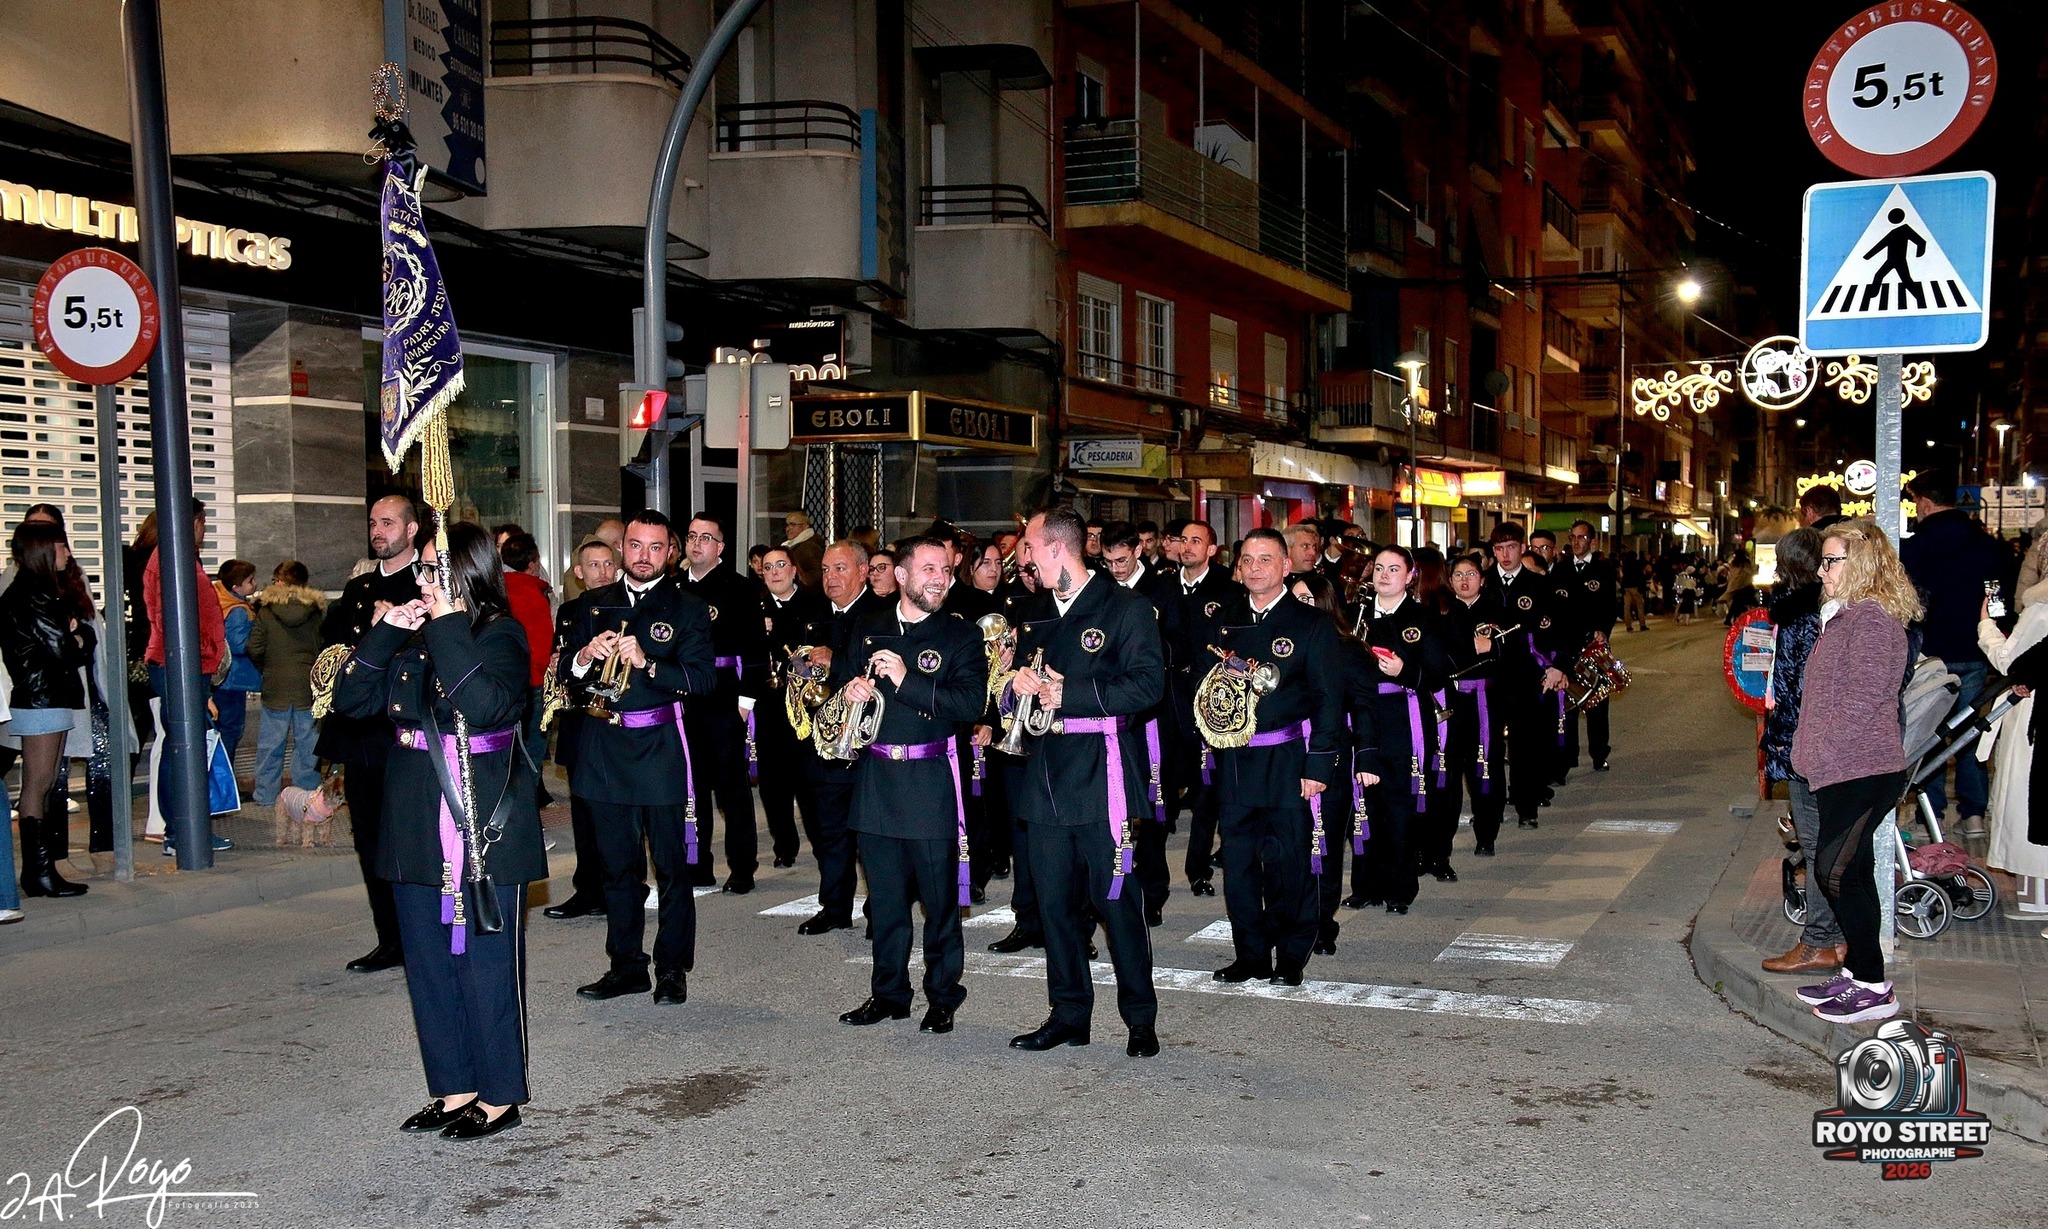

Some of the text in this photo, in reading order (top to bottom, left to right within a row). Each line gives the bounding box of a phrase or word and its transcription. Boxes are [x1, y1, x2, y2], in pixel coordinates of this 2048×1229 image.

[418, 2, 440, 34] RAFAEL
[409, 69, 443, 104] IMPLANTES
[1851, 62, 1945, 110] 5,5t
[64, 295, 124, 333] 5,5t
[402, 319, 435, 349] PADRE
[403, 320, 452, 363] AMARGURA
[811, 407, 891, 428] EBOLI
[950, 407, 1011, 442] EBOLI
